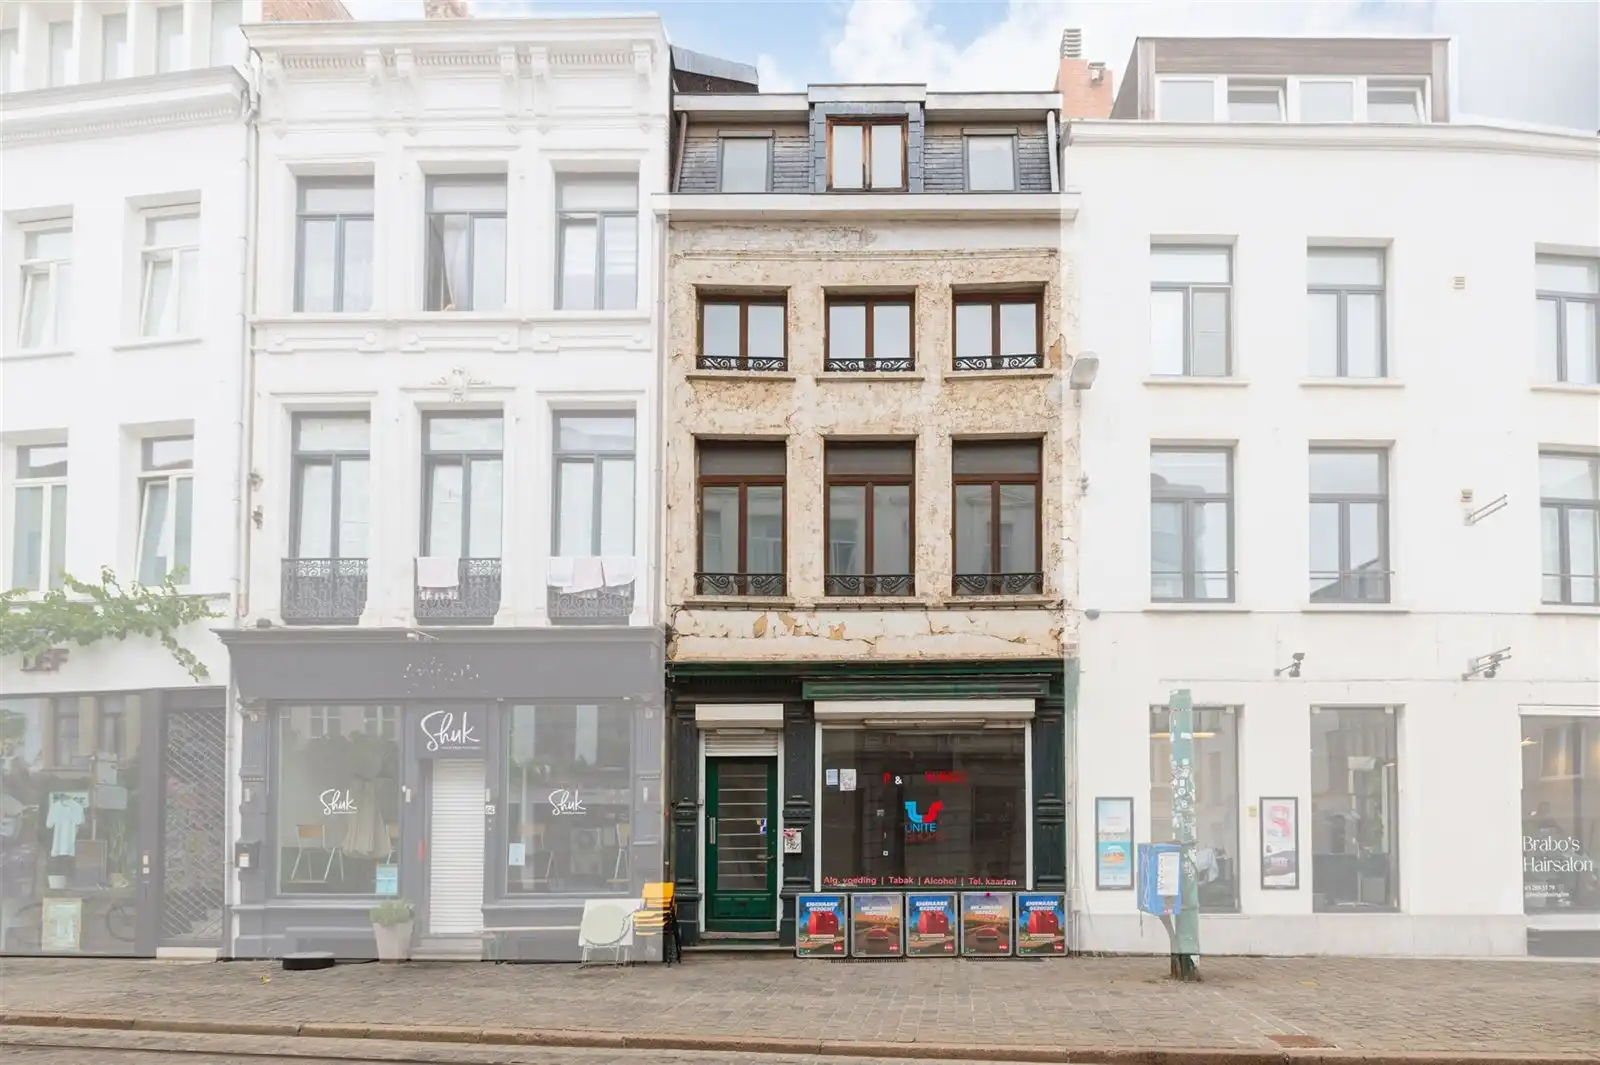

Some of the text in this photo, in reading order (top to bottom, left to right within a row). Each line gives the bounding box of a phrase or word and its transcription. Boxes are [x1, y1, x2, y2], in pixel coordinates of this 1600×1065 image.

[420, 709, 481, 752] Shuk
[320, 788, 358, 815] Shuk
[548, 788, 587, 815] Shuk
[1523, 856, 1593, 873] Hairsalon
[842, 876, 877, 886] voeding
[888, 876, 914, 885] Tabak
[924, 876, 957, 886] Alcohol
[968, 877, 983, 886] Tel.
[985, 877, 1017, 886] kaarten
